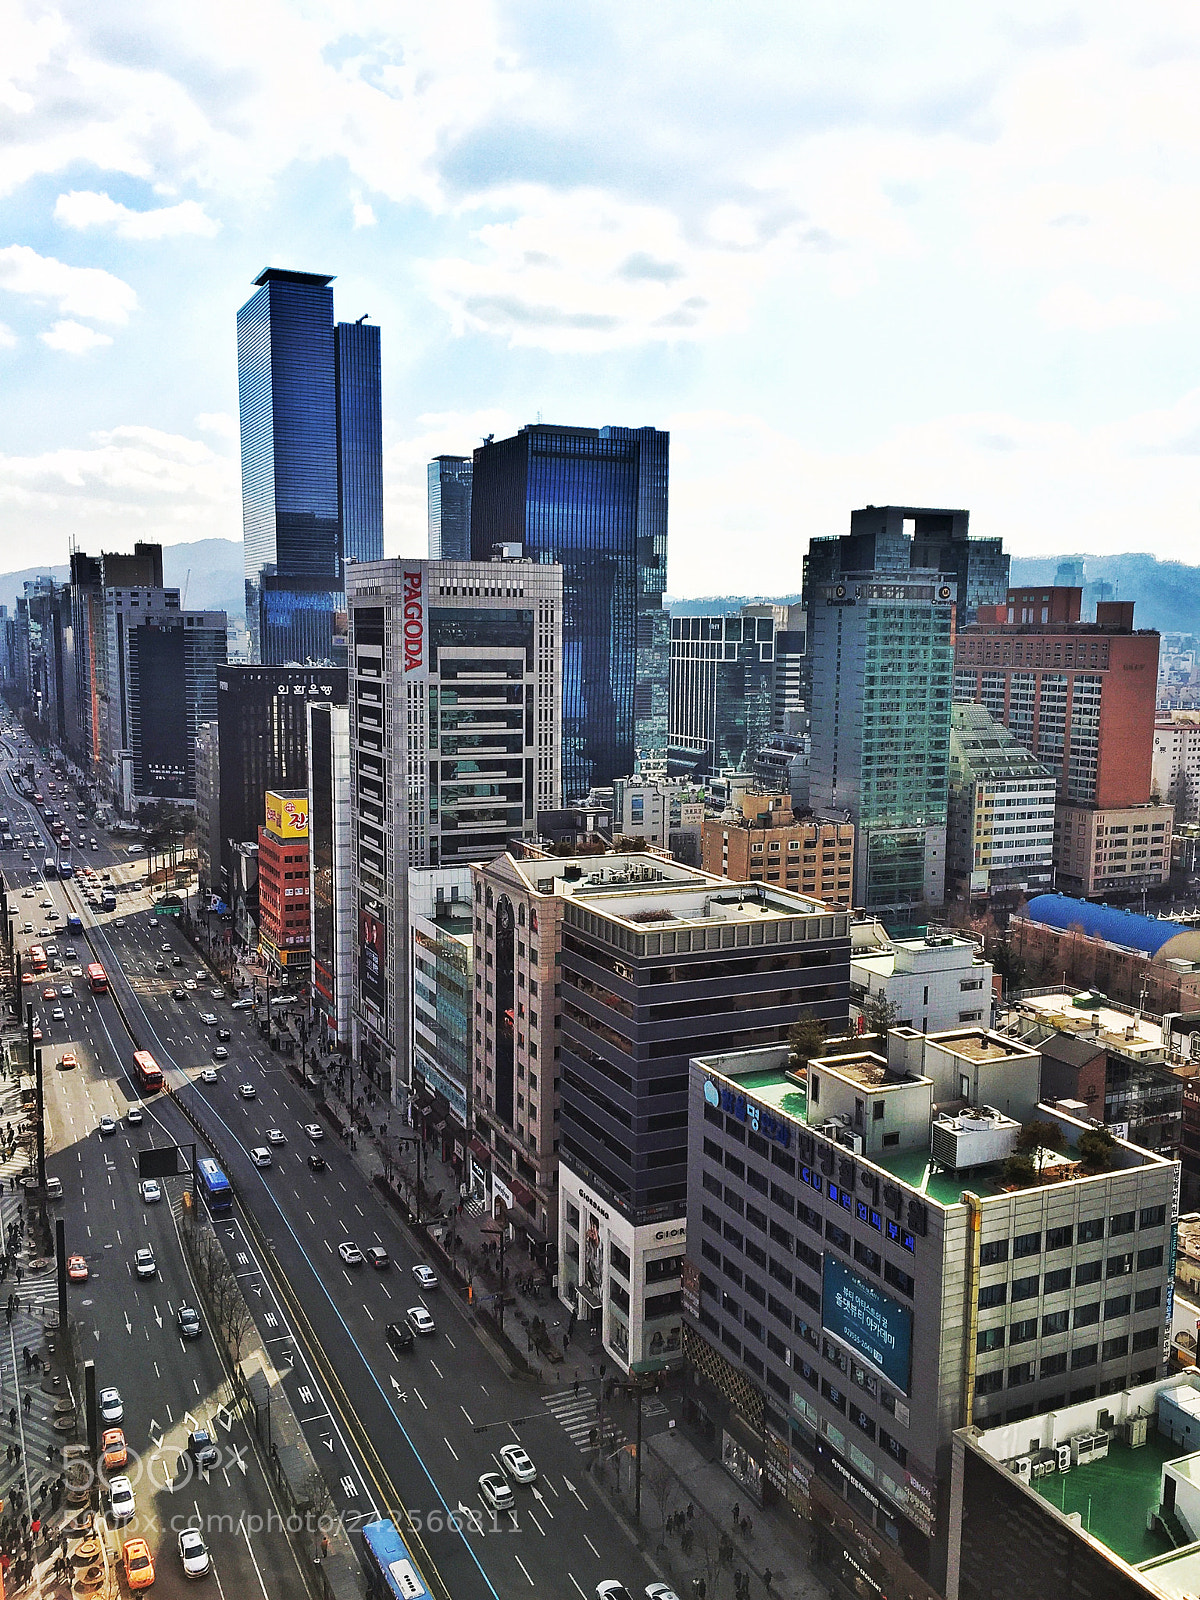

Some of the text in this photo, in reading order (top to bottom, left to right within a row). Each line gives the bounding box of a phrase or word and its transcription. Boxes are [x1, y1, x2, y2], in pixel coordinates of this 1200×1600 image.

[404, 571, 424, 673] PAGODA
[277, 683, 333, 696] 외환은행
[288, 812, 309, 831] 진
[578, 1188, 610, 1220] GIORDANO
[866, 1315, 896, 1350] 아카데미
